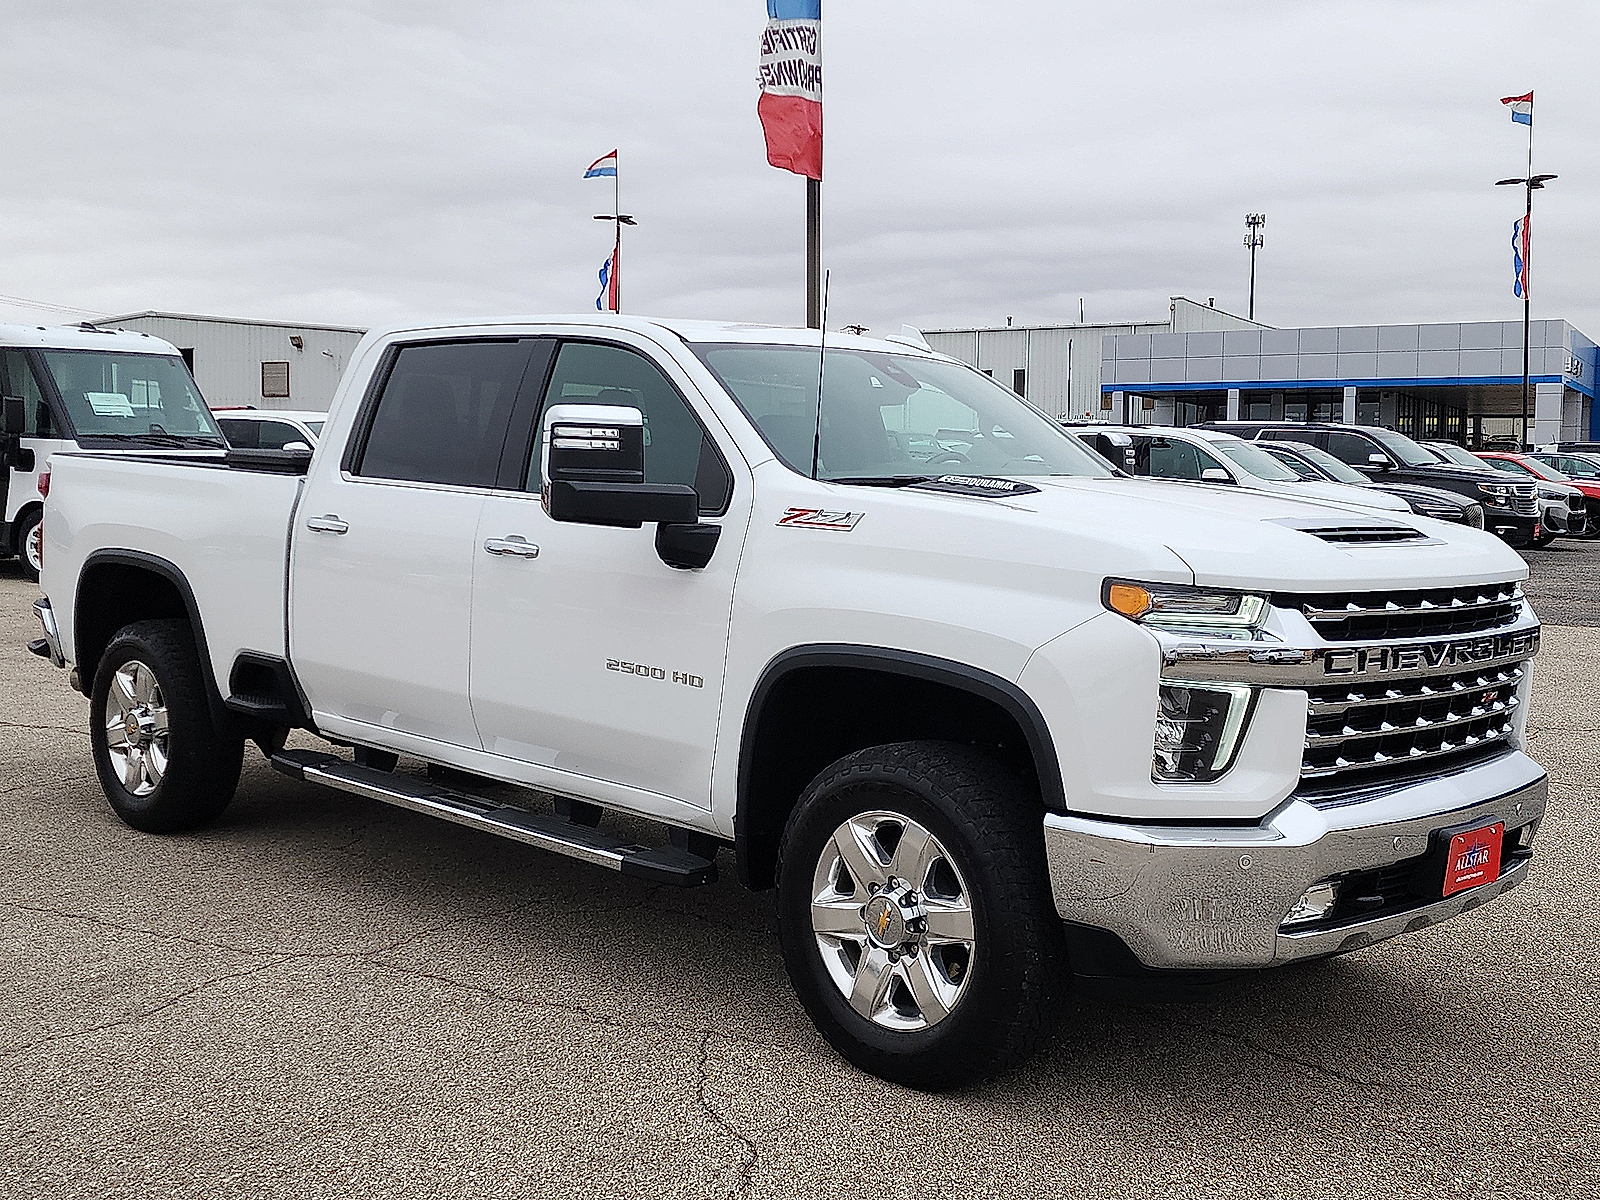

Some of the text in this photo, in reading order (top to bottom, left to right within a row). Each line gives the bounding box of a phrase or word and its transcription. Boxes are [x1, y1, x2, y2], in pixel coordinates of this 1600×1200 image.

[967, 477, 1017, 491] DURAMAX
[775, 505, 866, 532] Z71
[1323, 630, 1539, 676] CHEVROLET
[606, 658, 704, 689] 2500 HD
[1454, 849, 1489, 872] ALLSTAR
